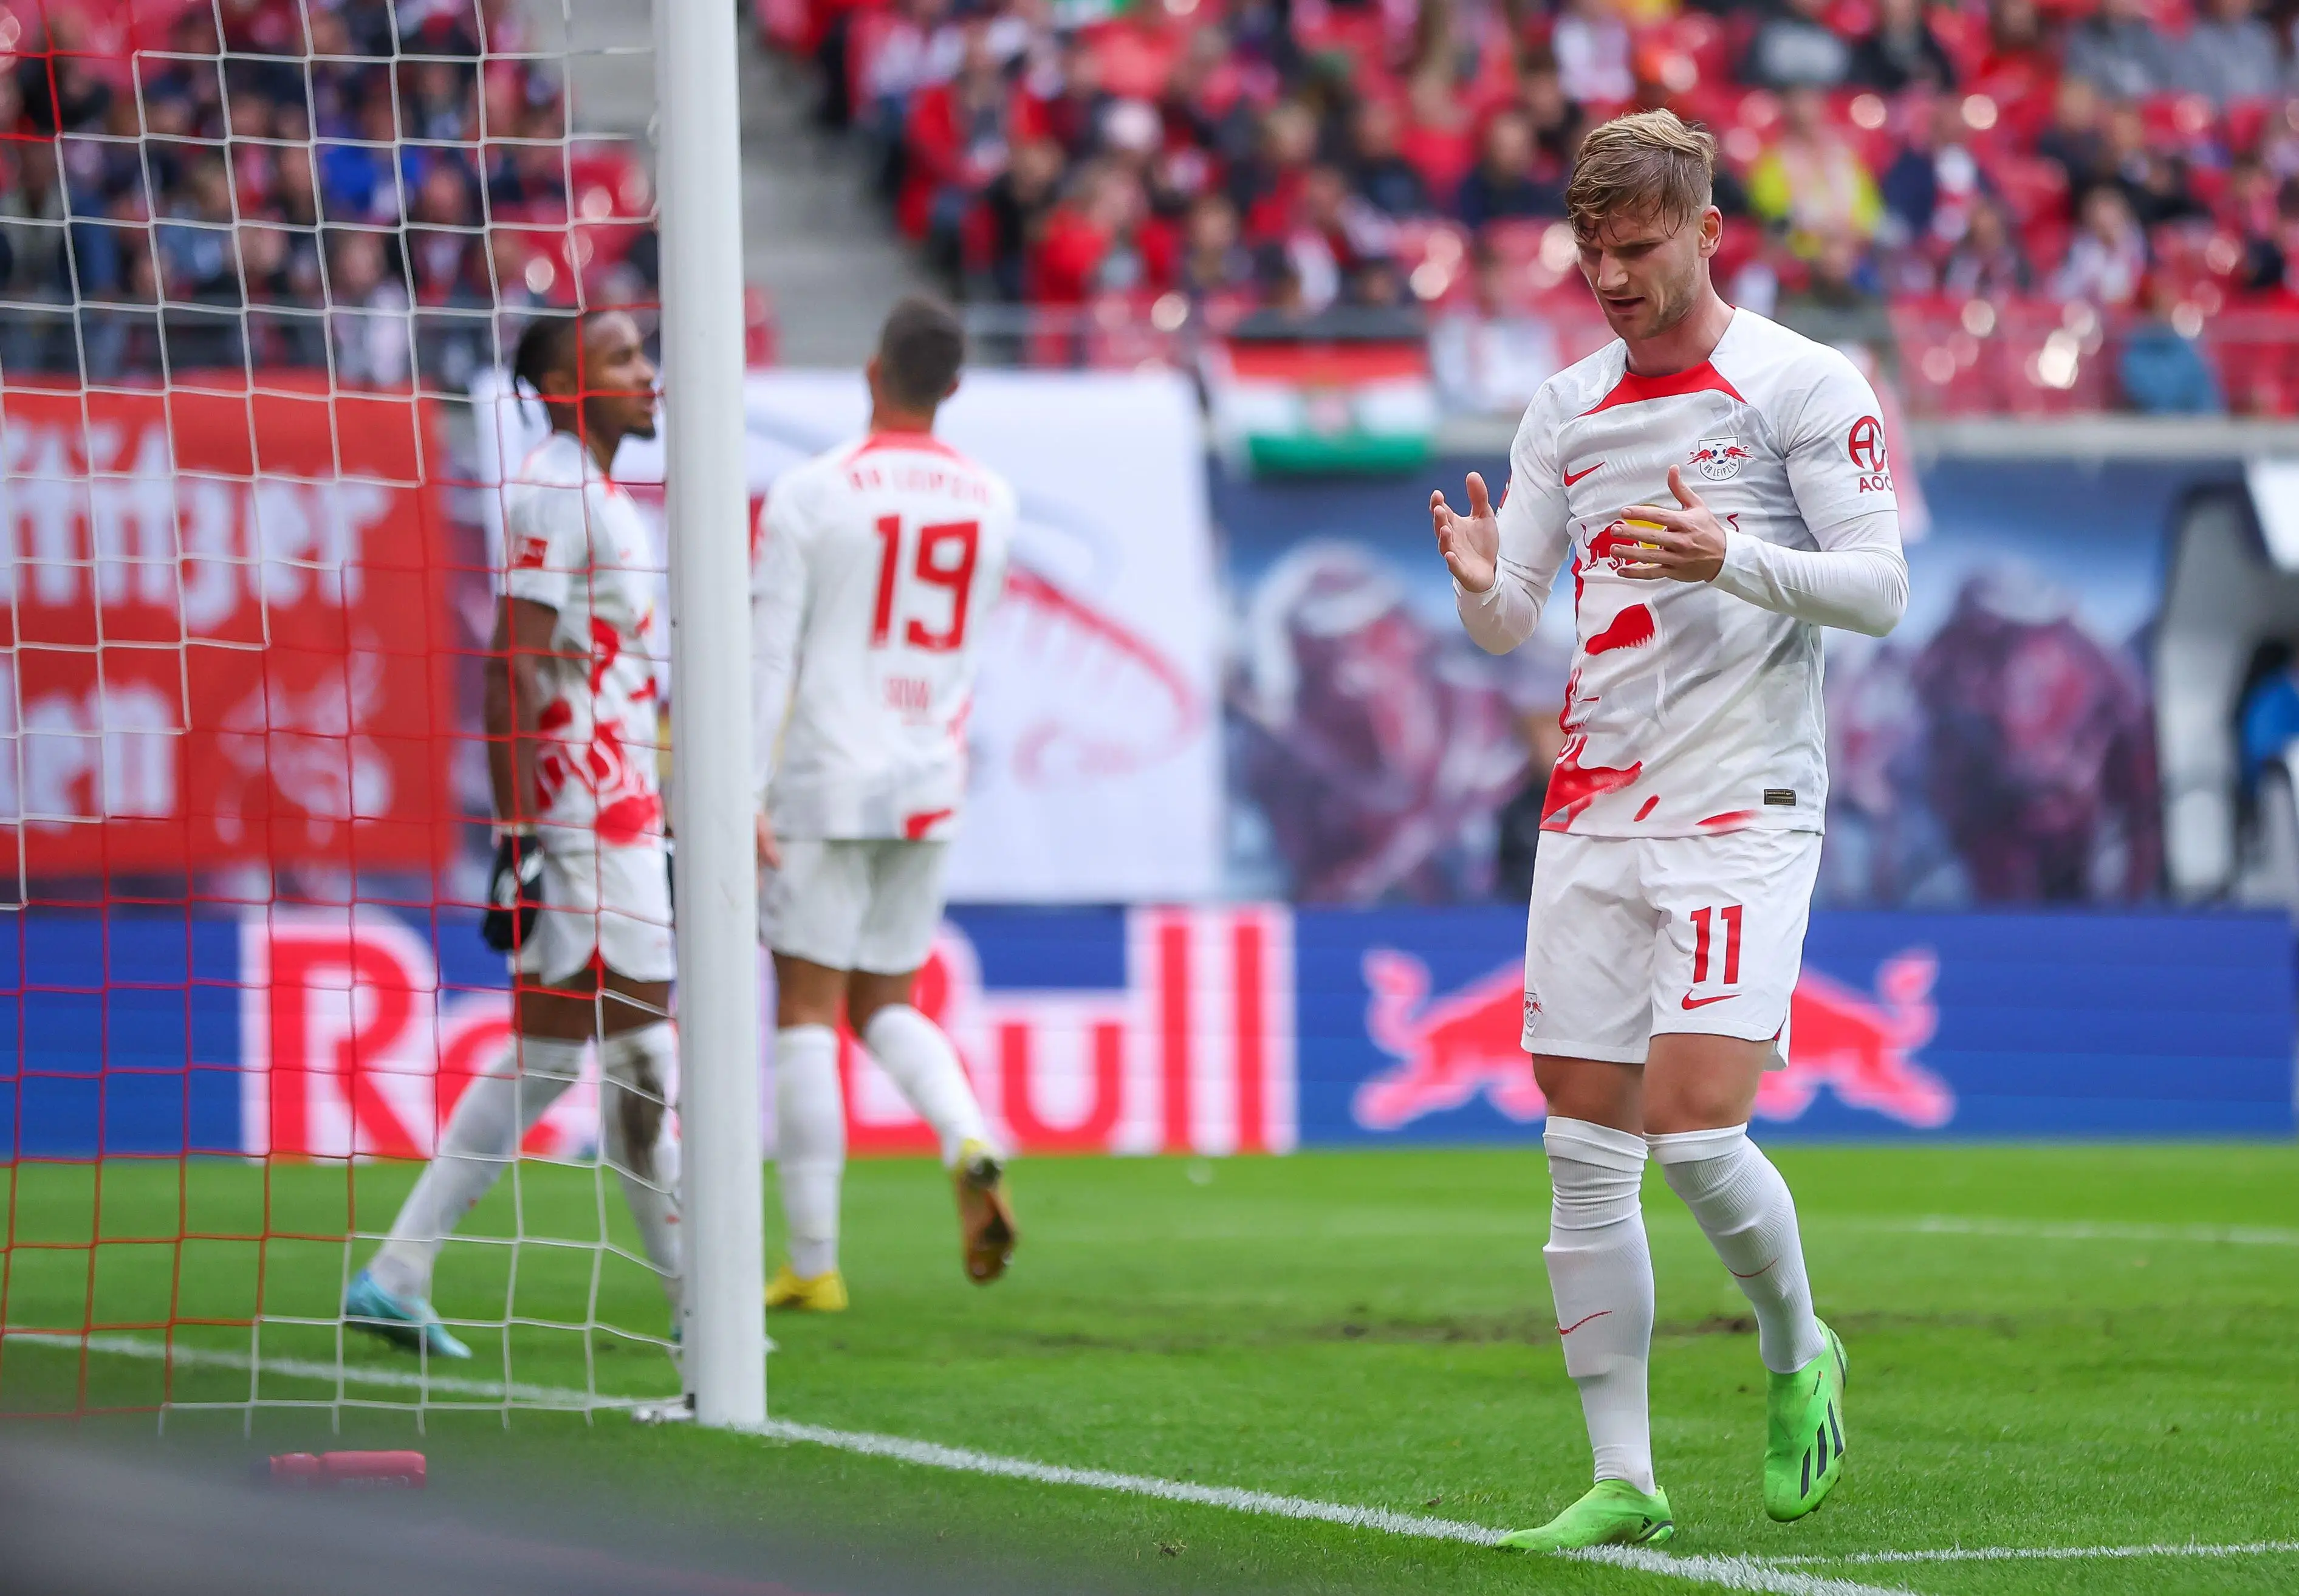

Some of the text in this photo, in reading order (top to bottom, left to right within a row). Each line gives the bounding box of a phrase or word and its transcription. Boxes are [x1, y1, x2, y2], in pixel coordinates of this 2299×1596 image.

[1713, 462, 1737, 477] LEIPZIG
[1859, 475, 1893, 493] AOC
[869, 513, 979, 652] 19
[1690, 904, 1742, 985] 11
[240, 916, 671, 1163] Re
